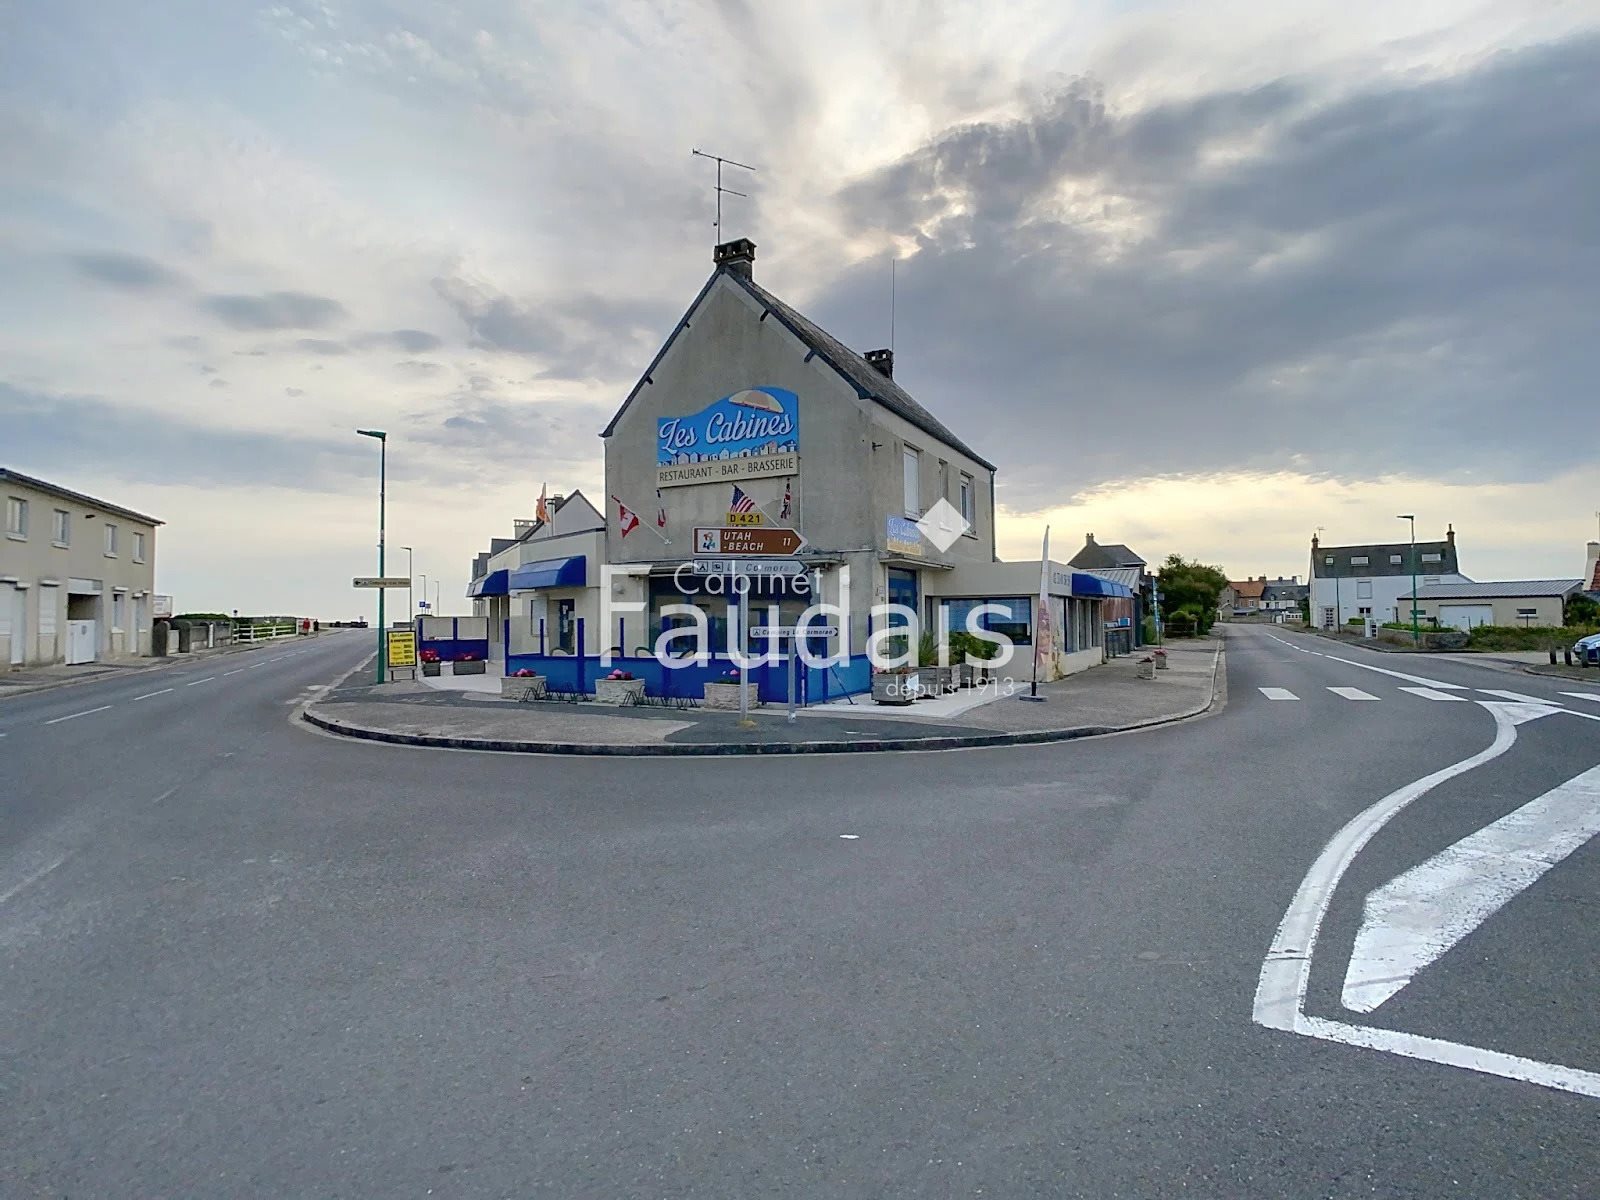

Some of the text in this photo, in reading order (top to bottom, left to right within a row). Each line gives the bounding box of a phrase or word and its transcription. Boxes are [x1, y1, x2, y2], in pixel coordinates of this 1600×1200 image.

[659, 410, 794, 454] Les Cabines
[659, 466, 713, 482] RESTAURANT
[721, 463, 739, 476] BAR
[748, 457, 794, 473] BRASSERIE
[730, 514, 760, 523] D 421
[723, 531, 791, 546] UTAH 11
